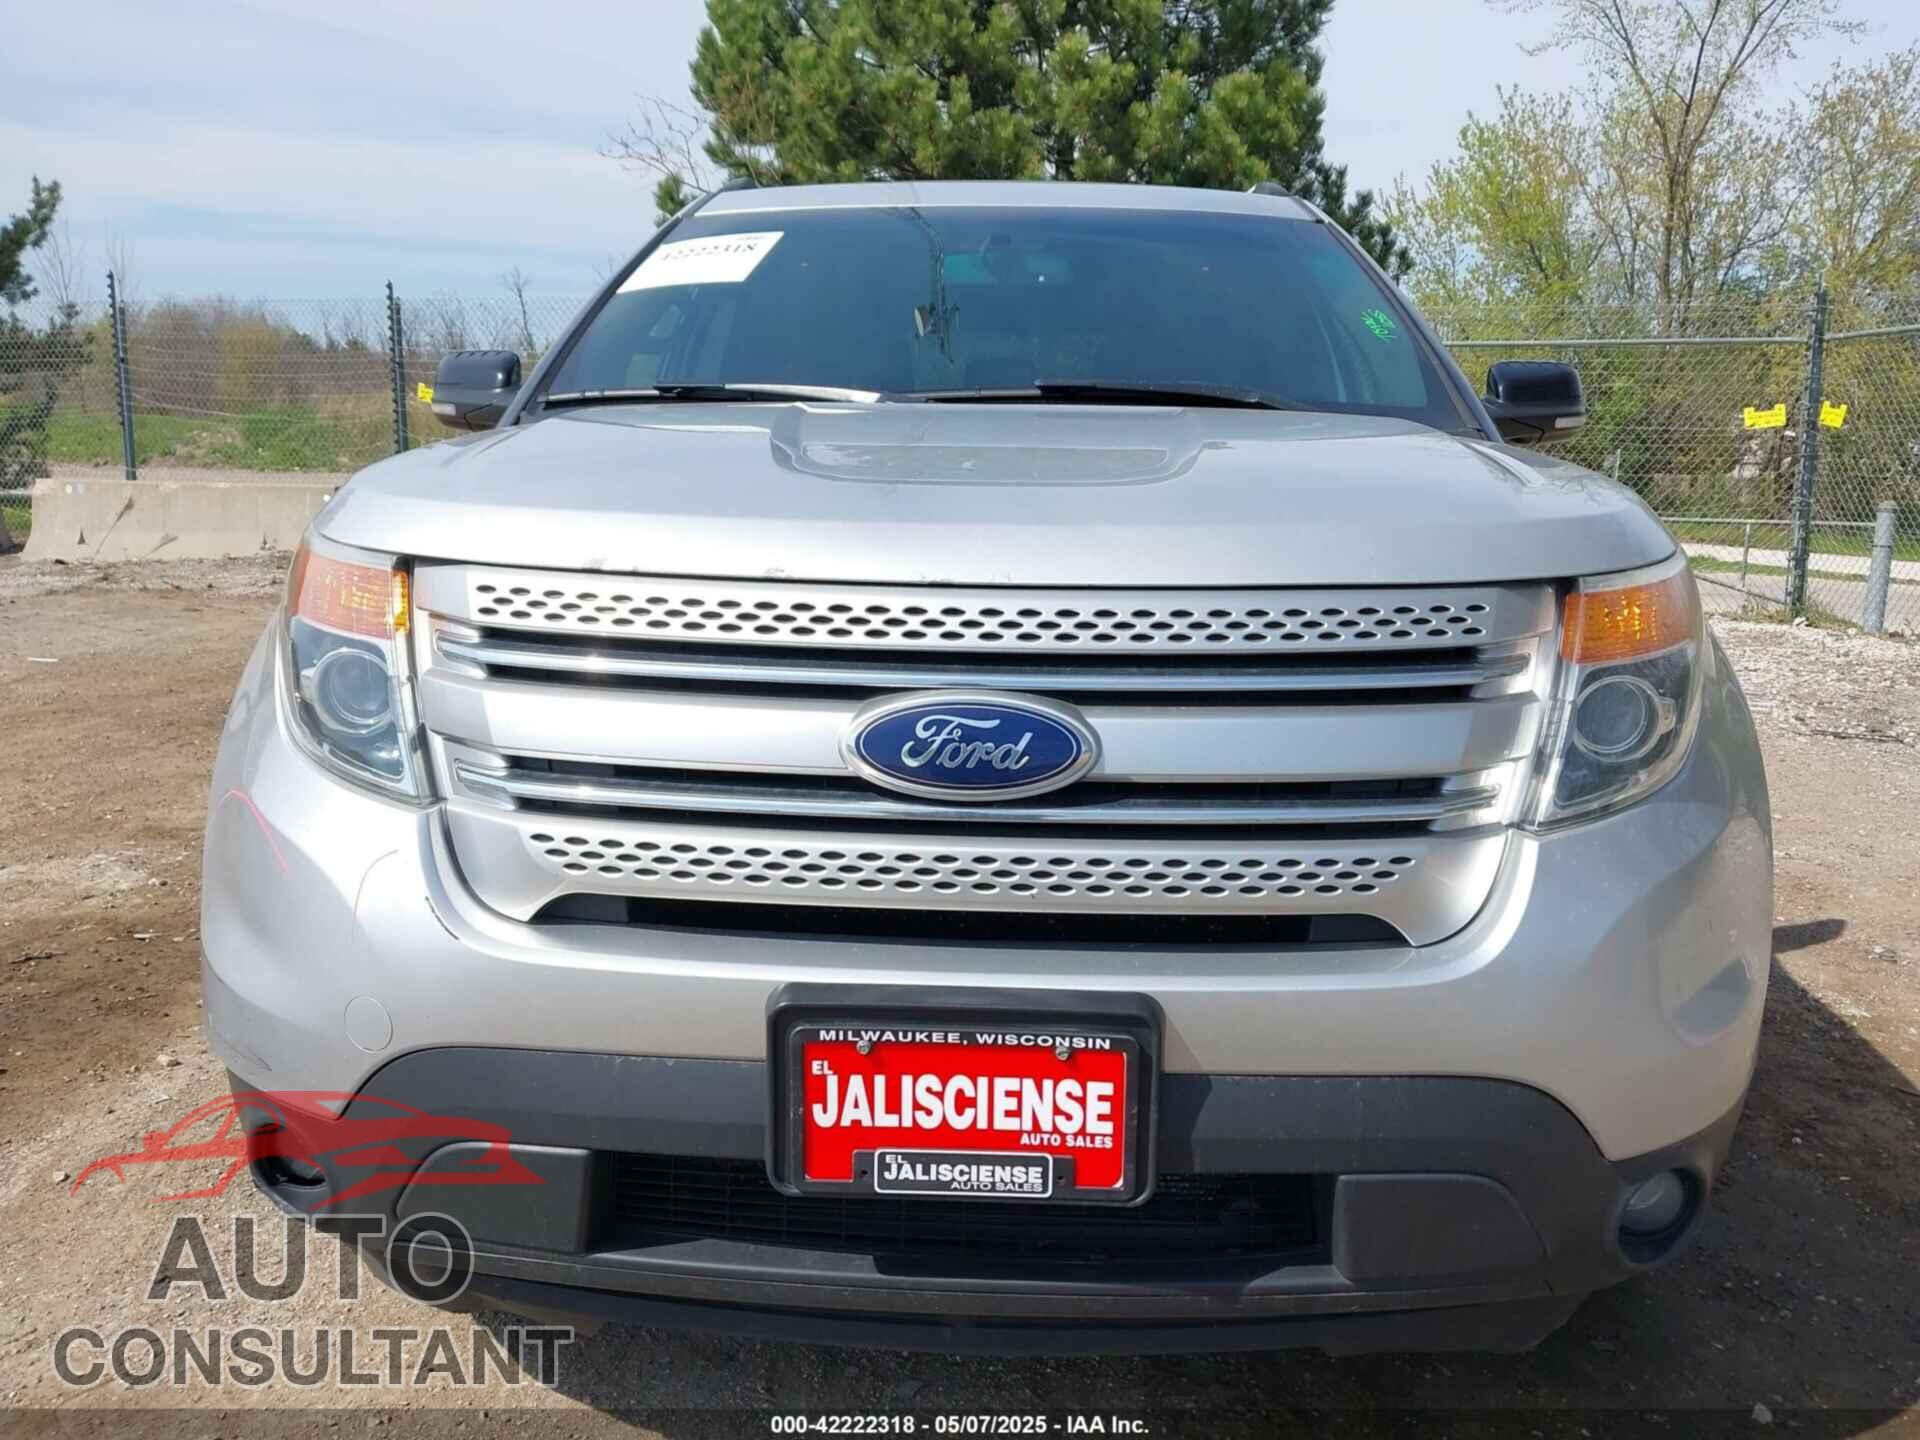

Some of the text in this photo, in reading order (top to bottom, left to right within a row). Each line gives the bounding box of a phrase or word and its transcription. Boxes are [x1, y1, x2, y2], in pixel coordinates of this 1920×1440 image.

[900, 714, 1034, 770] Ford
[819, 1029, 1111, 1050] MILWAUKEE, WISCONSIN
[811, 1060, 833, 1074] EL
[812, 1074, 1114, 1134] JALISCIENSE
[1019, 1132, 1113, 1148] AUTO SALES
[885, 1153, 907, 1164] EL
[883, 1163, 1044, 1183] JALISCIENSE
[950, 1180, 1043, 1193] AUTO SALES
